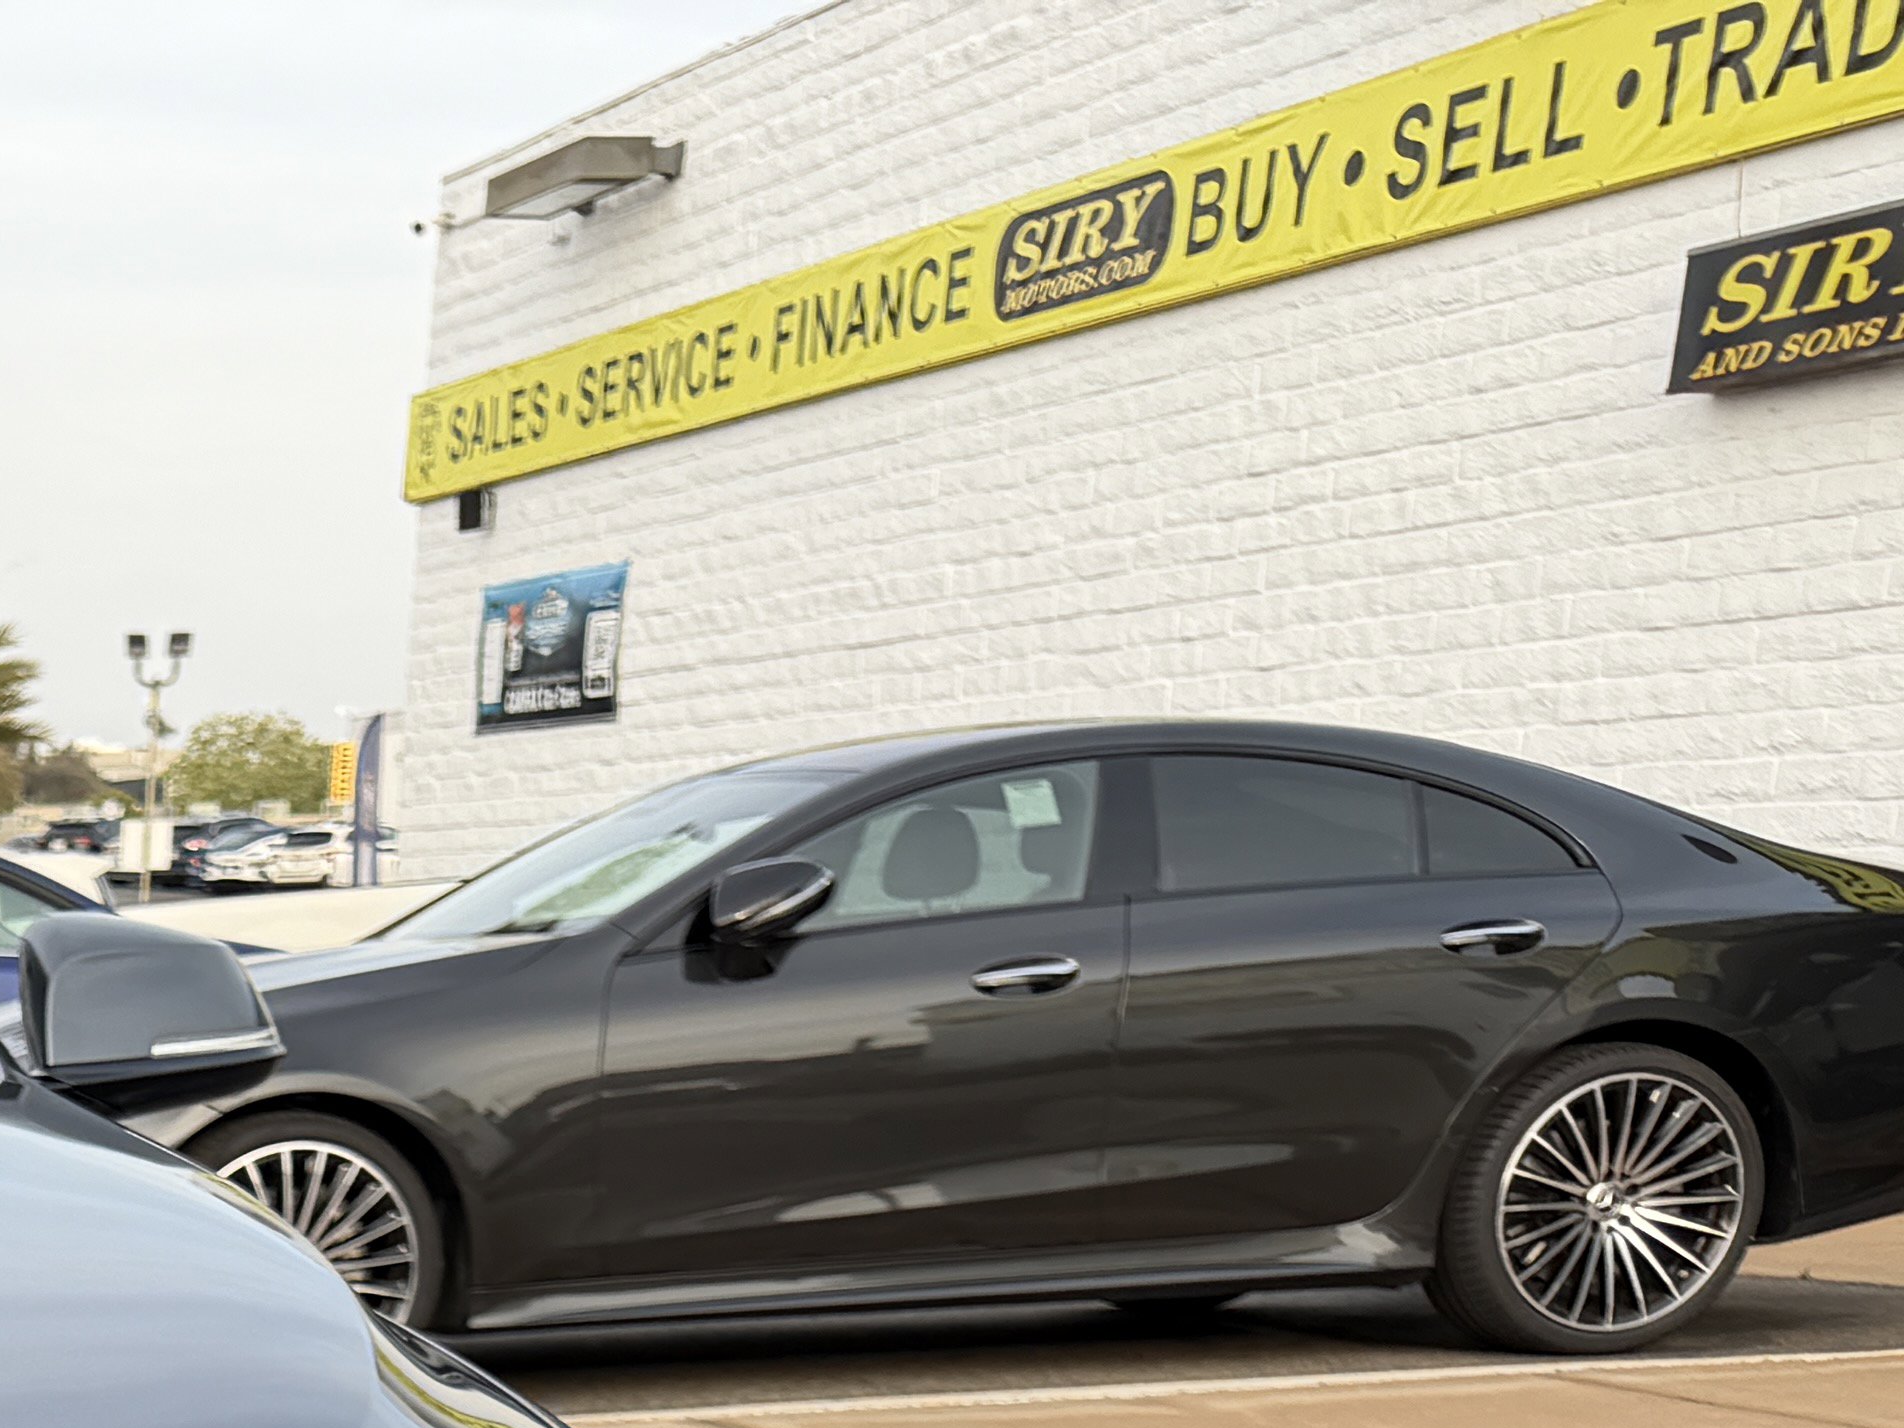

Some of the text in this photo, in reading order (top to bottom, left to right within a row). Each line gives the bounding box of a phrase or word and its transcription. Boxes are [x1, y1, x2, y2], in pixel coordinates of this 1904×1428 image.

[1187, 131, 1331, 259] BUY
[1386, 60, 1584, 201] SELL
[1000, 249, 1157, 314] MOTORS.COM
[1002, 180, 1167, 286] SIRY
[1699, 222, 1904, 336] SIR
[445, 380, 550, 464] SALES
[574, 320, 739, 428] SERVICE
[768, 245, 976, 374] FINANCE
[1689, 340, 1773, 381] AND
[1778, 315, 1889, 364] SONS
